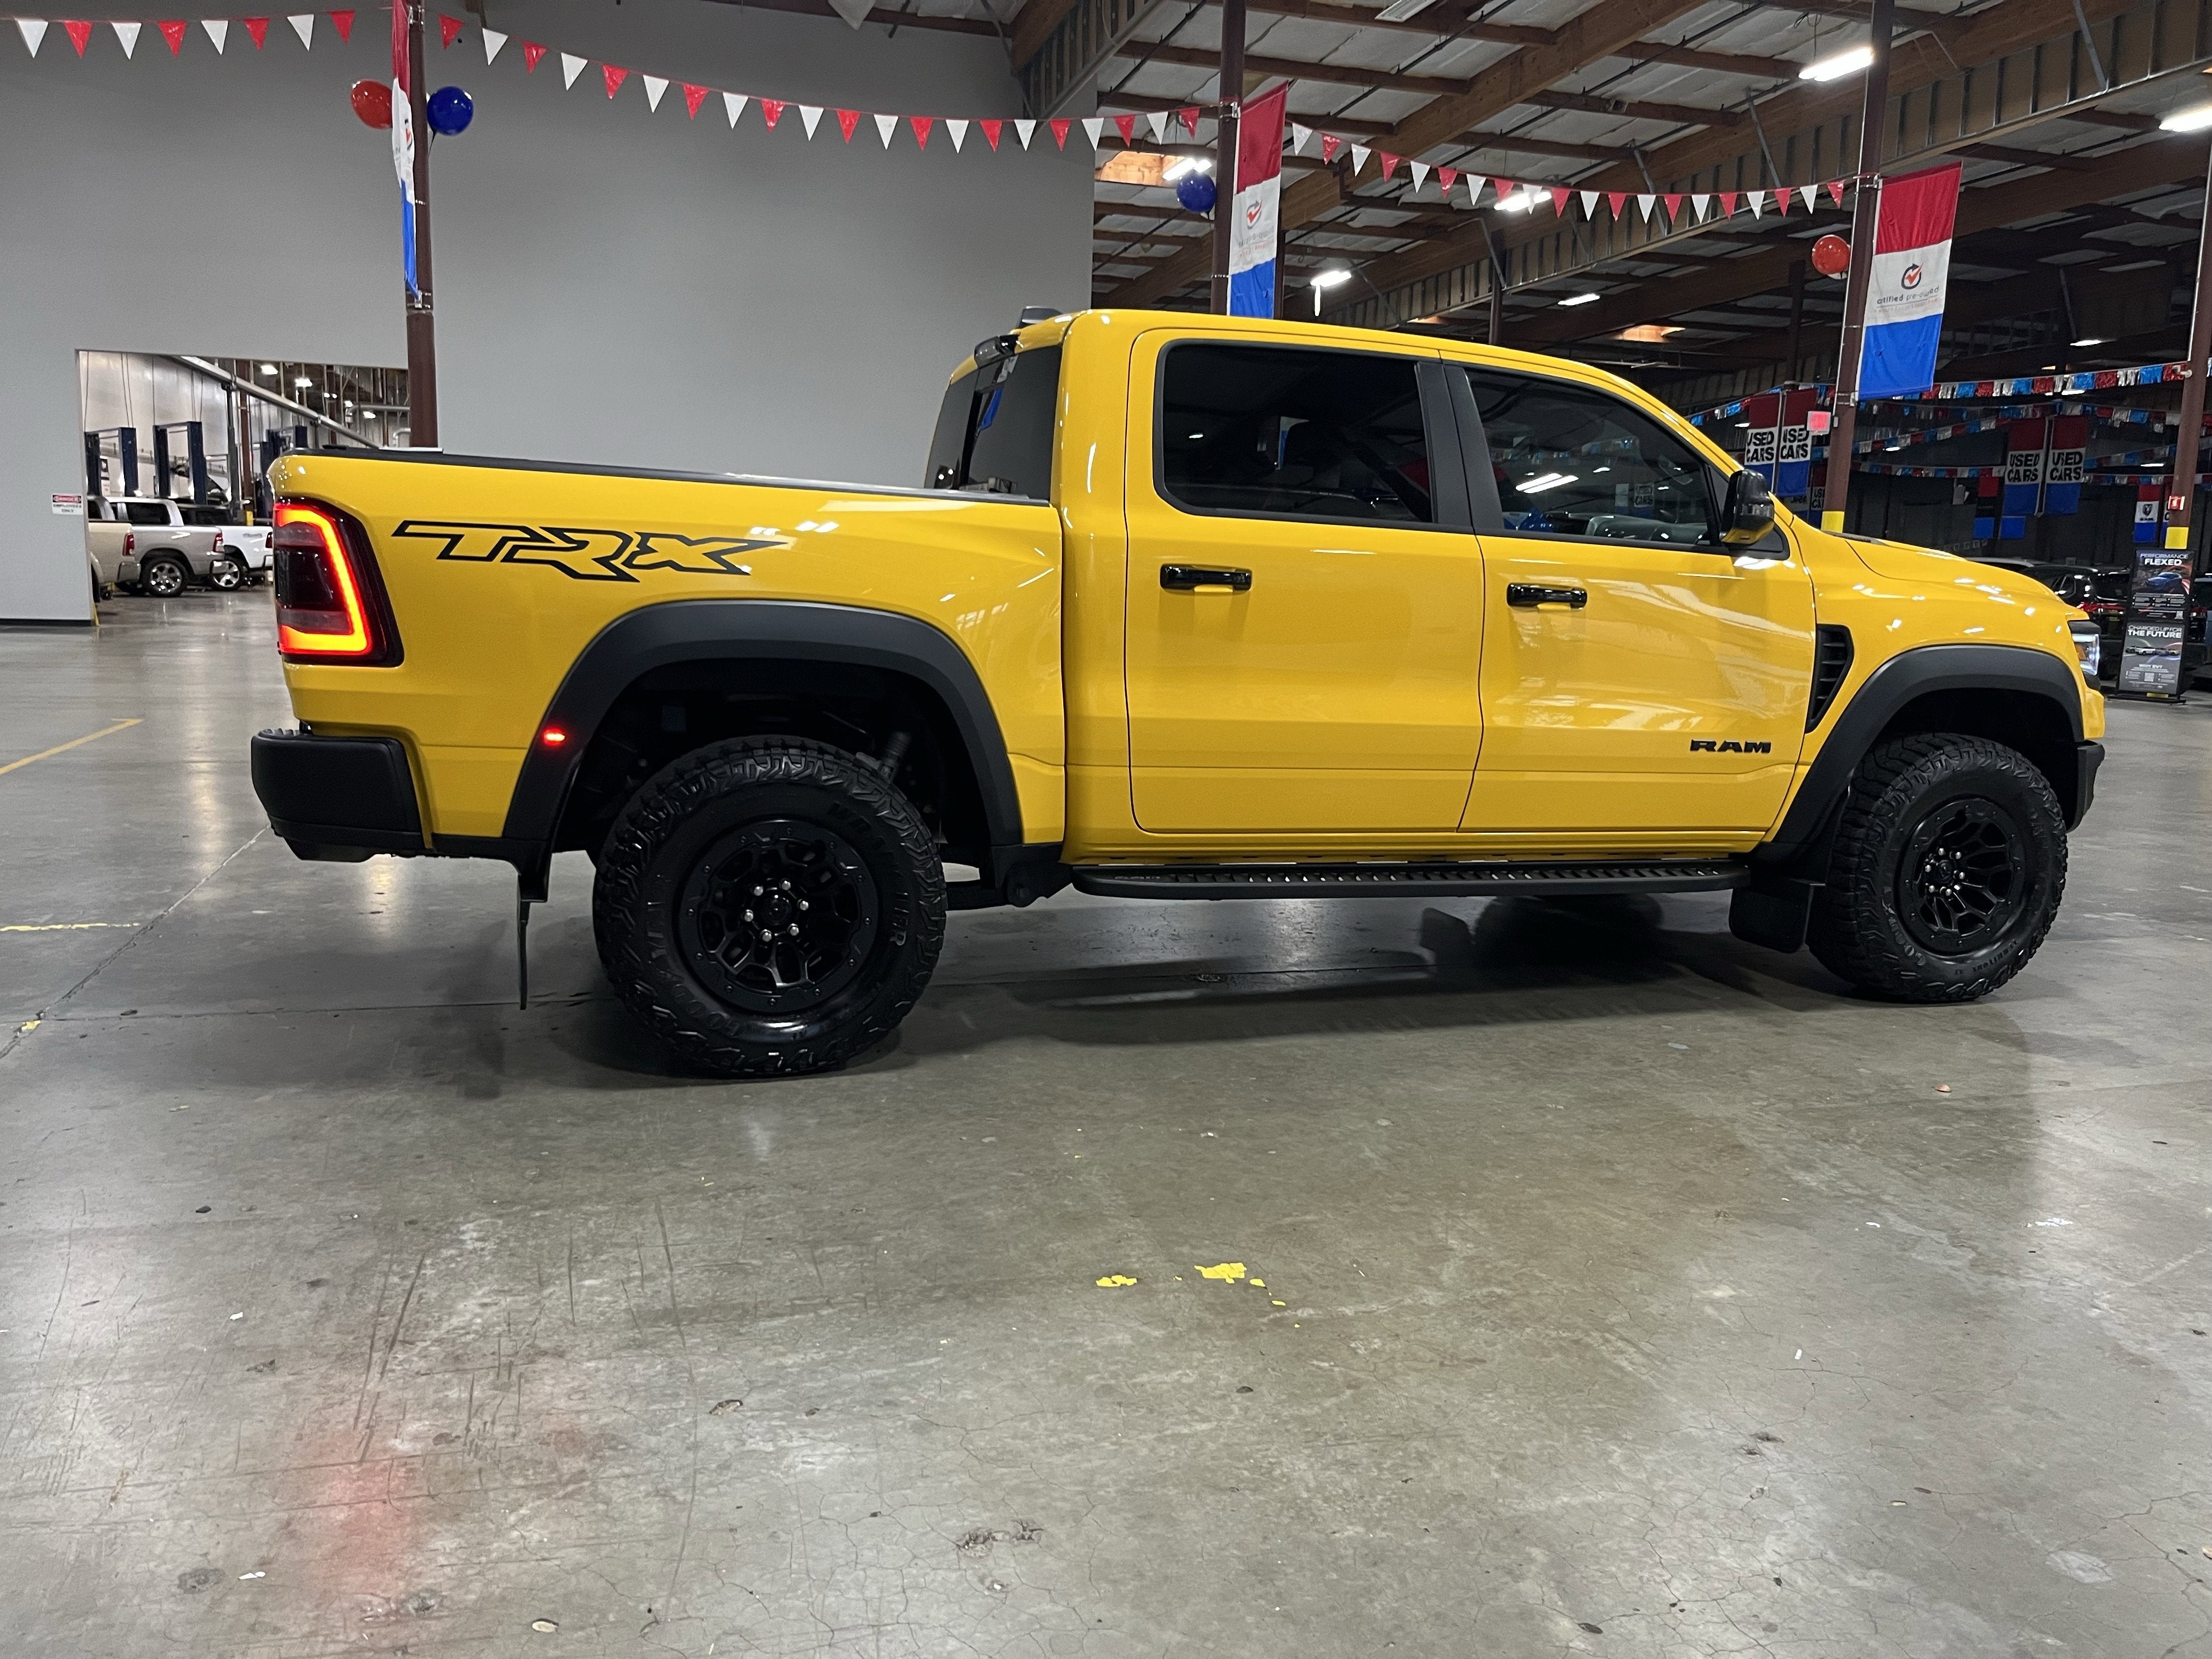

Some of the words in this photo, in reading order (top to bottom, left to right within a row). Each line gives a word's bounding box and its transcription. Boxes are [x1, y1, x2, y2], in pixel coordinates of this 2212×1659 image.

[2010, 453, 2040, 467] USED
[2052, 451, 2083, 466] USED
[2007, 467, 2039, 482] CARS
[2050, 466, 2082, 481] CARS
[1814, 488, 1825, 498] US
[1812, 499, 1824, 509] CA
[391, 519, 788, 583] TRX
[2145, 558, 2182, 566] FLEXED
[1690, 740, 1771, 754] RAM
